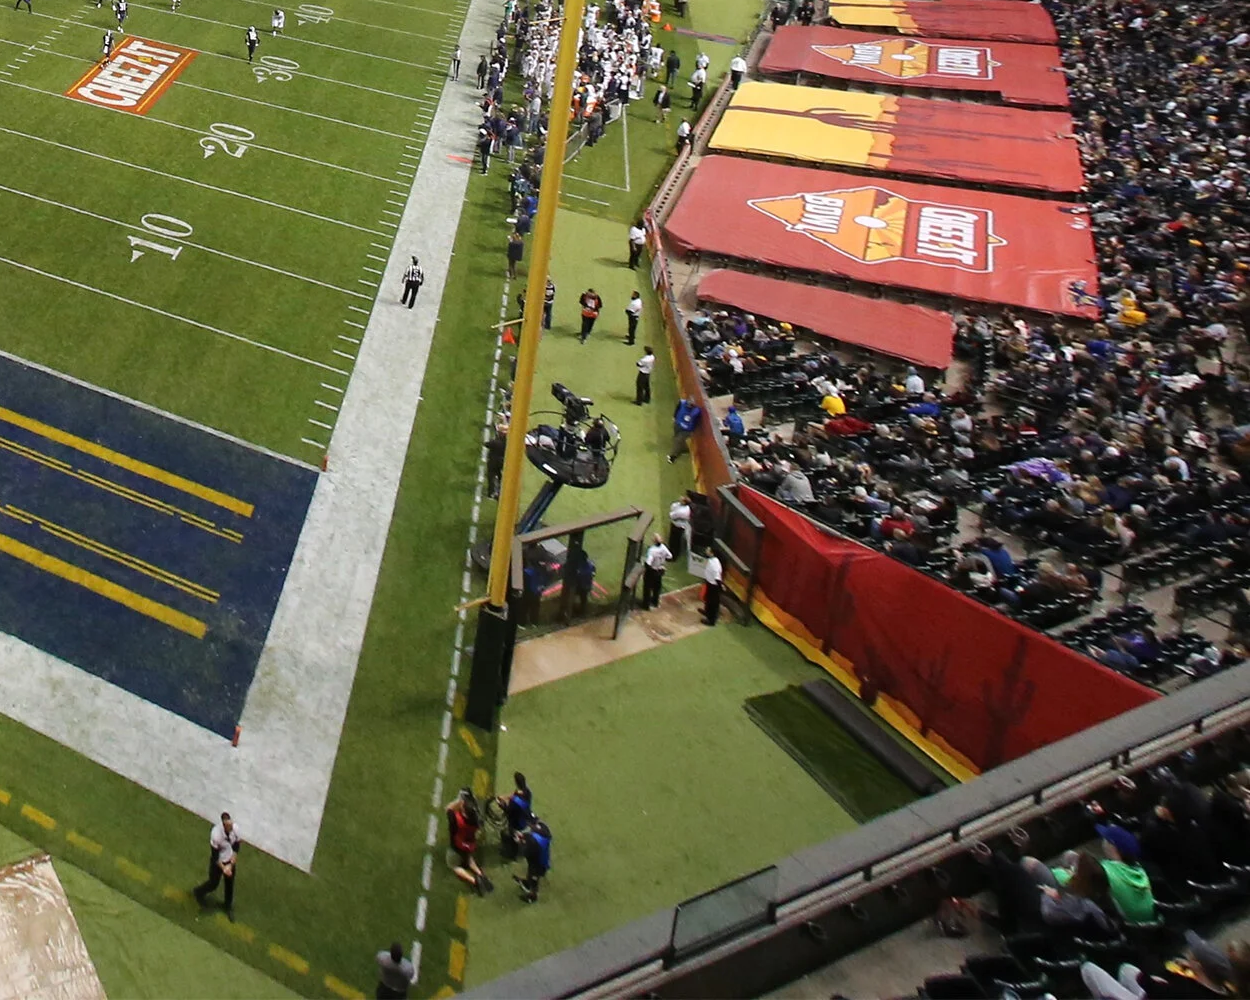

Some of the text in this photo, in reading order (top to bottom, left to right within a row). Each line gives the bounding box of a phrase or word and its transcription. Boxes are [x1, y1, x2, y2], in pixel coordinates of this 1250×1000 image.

[294, 3, 334, 24] 40
[253, 55, 299, 82] 30
[199, 123, 255, 158] 20
[793, 193, 847, 234] BOWL
[127, 213, 193, 261] 10
